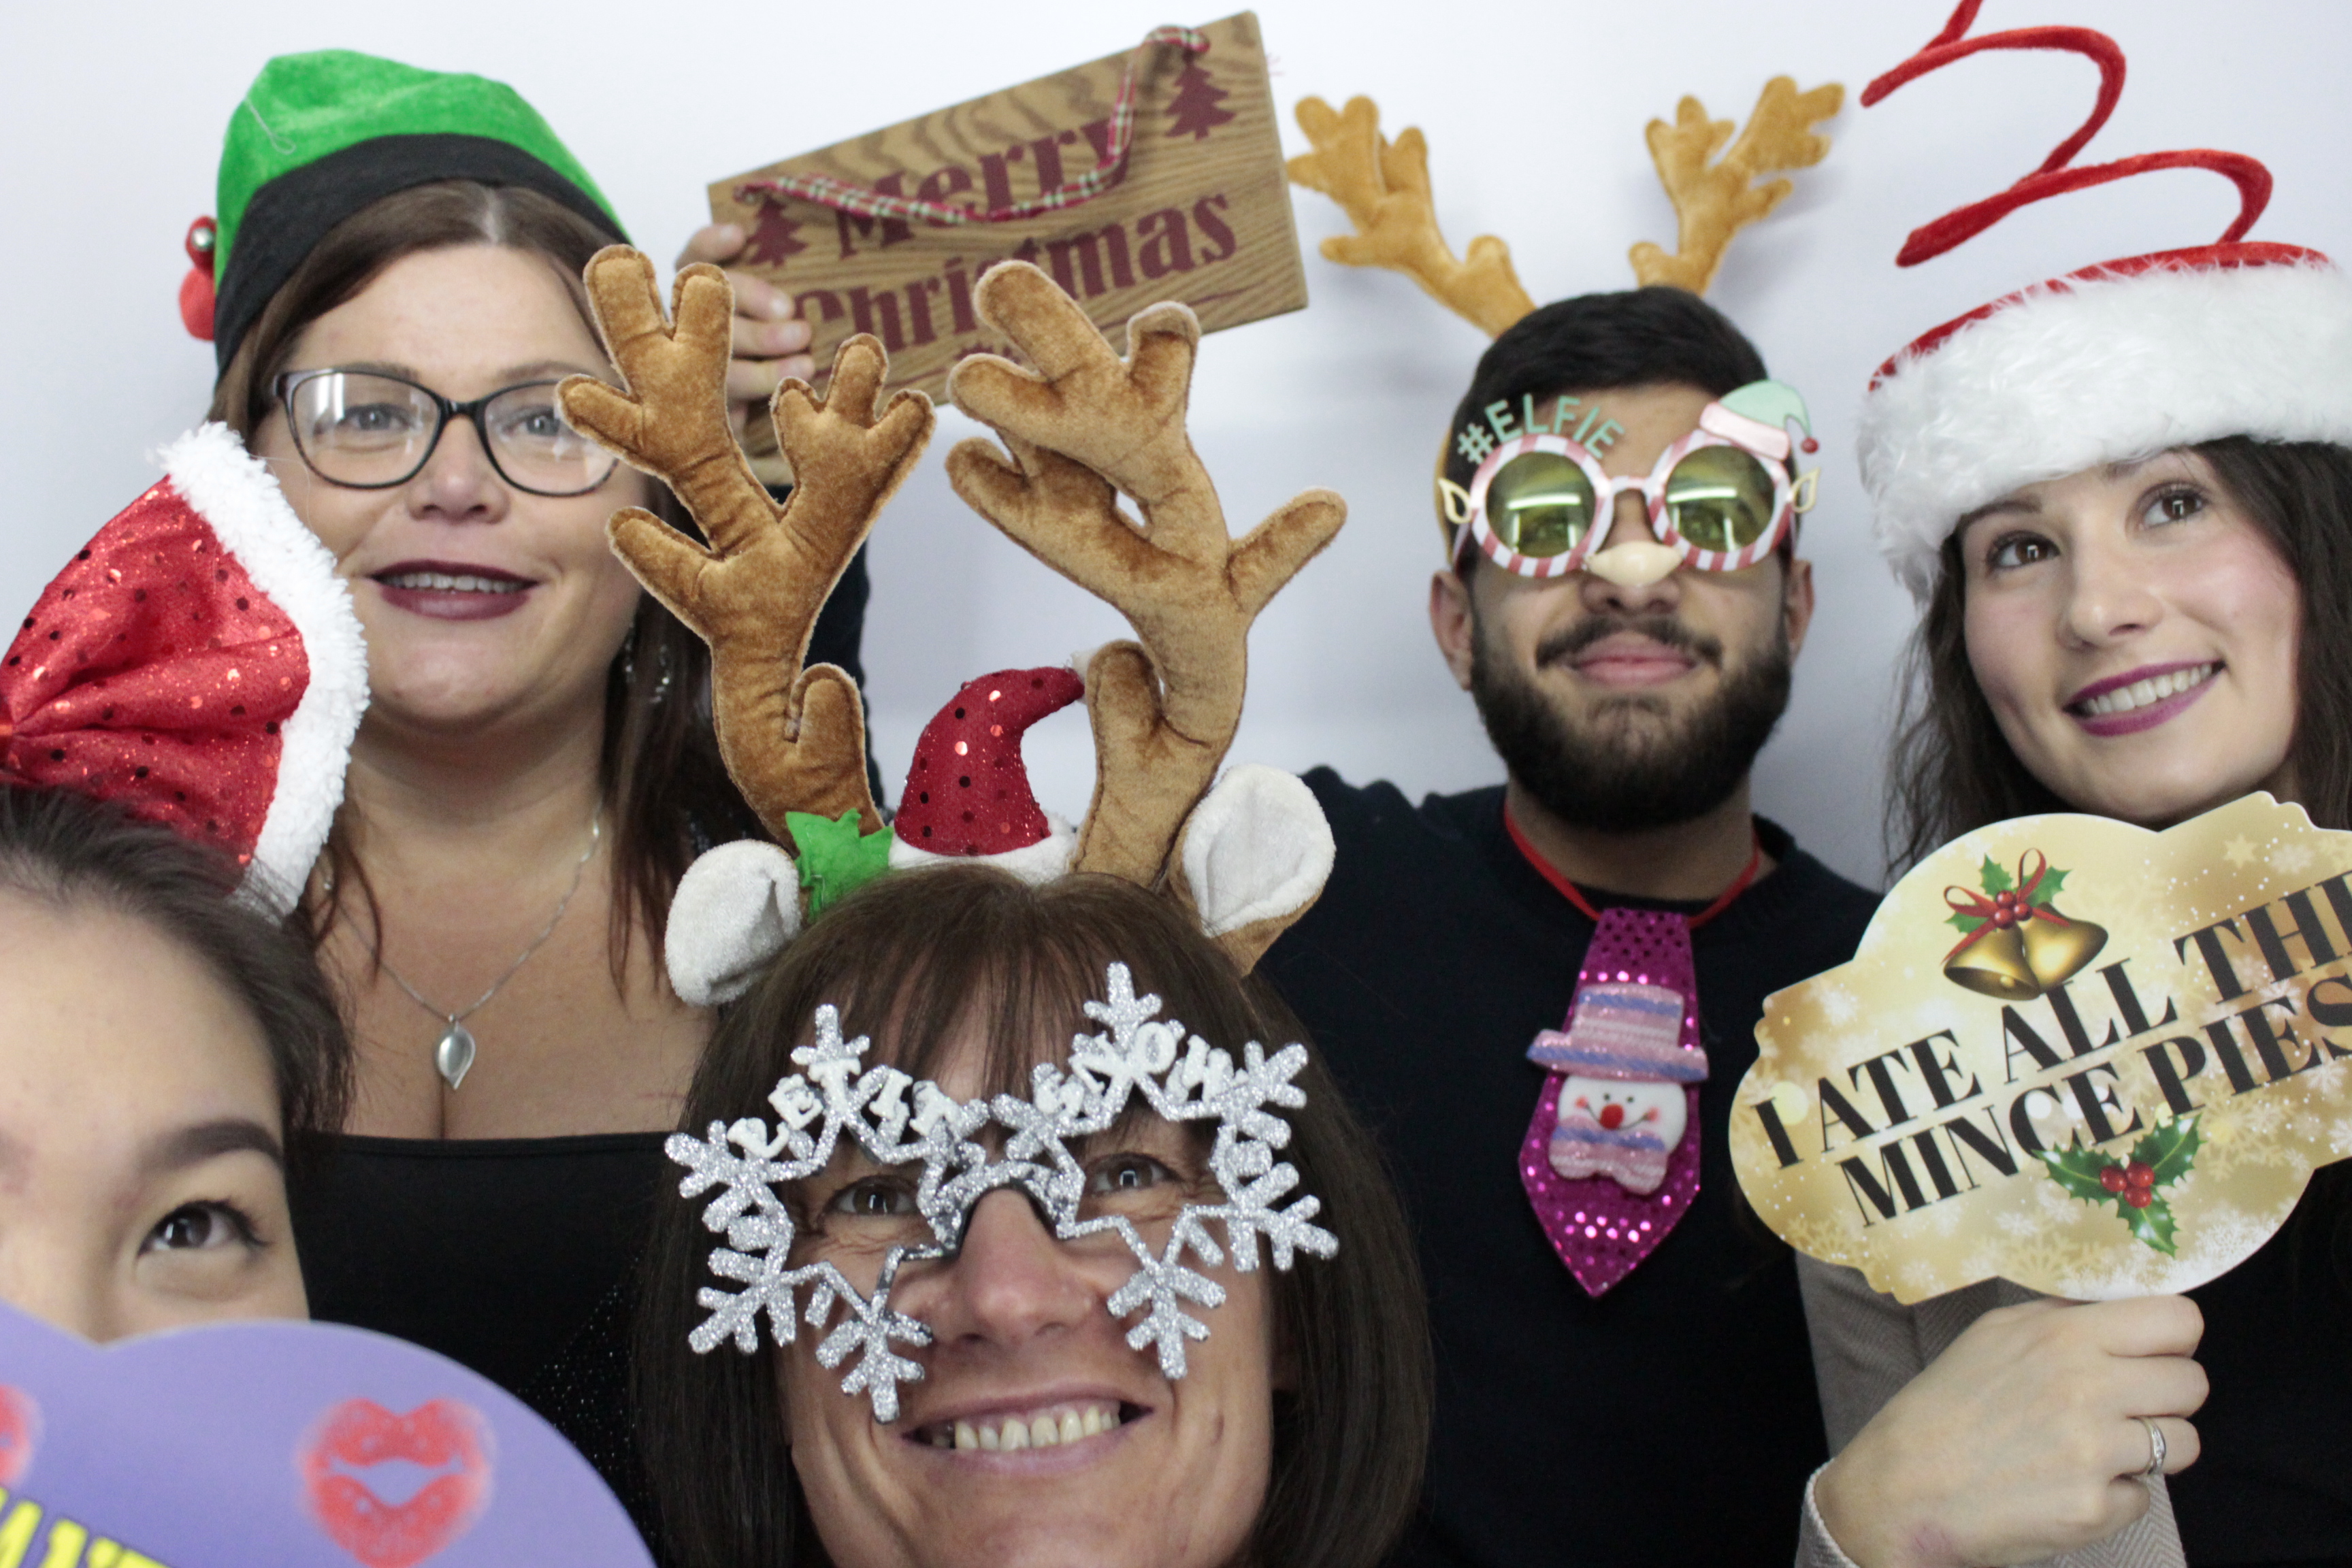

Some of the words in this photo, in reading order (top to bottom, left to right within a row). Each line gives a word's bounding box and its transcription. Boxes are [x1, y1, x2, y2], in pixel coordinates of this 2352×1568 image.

[794, 193, 1237, 357] hrimas
[1456, 393, 1625, 465] #ELFIE
[1750, 1098, 1804, 1170] I
[1816, 1028, 1983, 1153] ATE
[2002, 958, 2178, 1085] ALL
[1835, 1062, 2144, 1228] MINCE
[2136, 973, 2352, 1120] PIES
